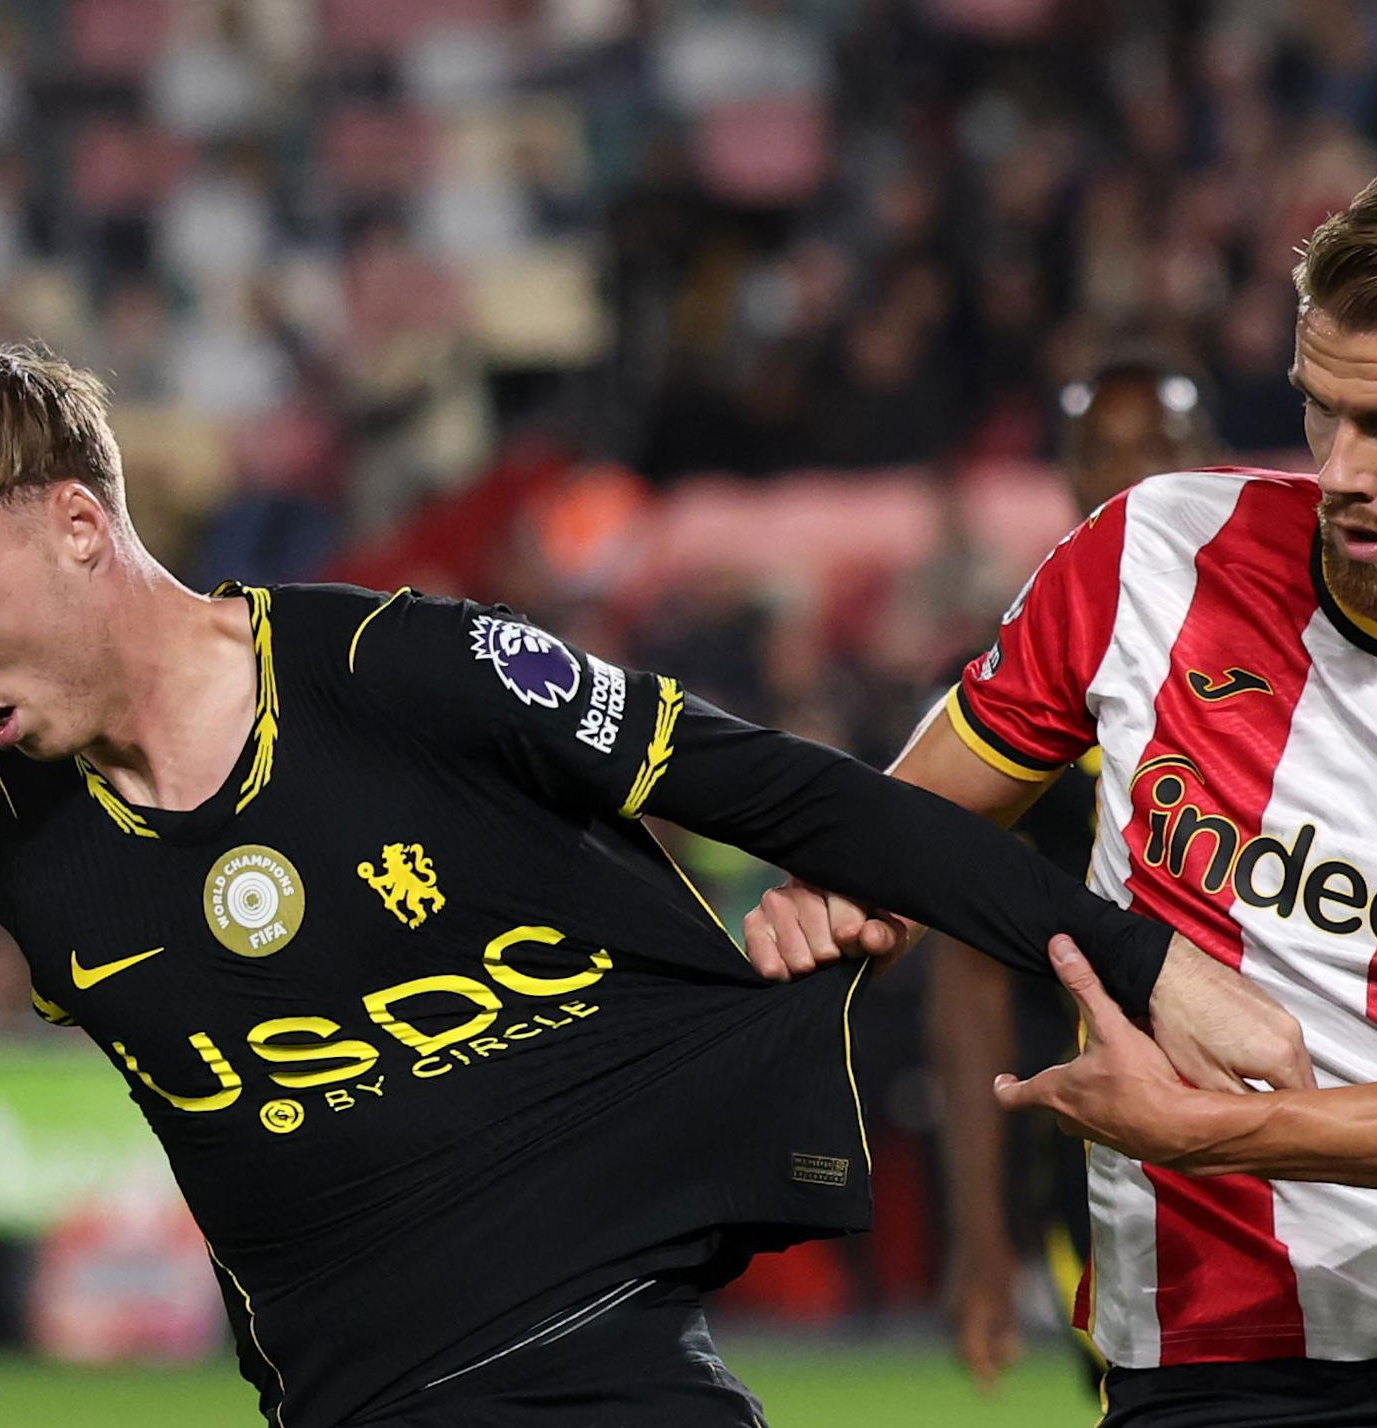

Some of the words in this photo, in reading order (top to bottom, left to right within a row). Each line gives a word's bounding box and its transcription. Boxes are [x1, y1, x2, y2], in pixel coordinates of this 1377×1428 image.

[575, 709, 603, 746] No
[593, 715, 619, 754] for
[212, 876, 230, 929] WORLD
[224, 854, 295, 896] CHAMPIONS
[249, 920, 288, 949] FIFA
[111, 925, 614, 1112] USDC
[324, 1075, 385, 1112] BY
[412, 1000, 599, 1078] CIRCLE
